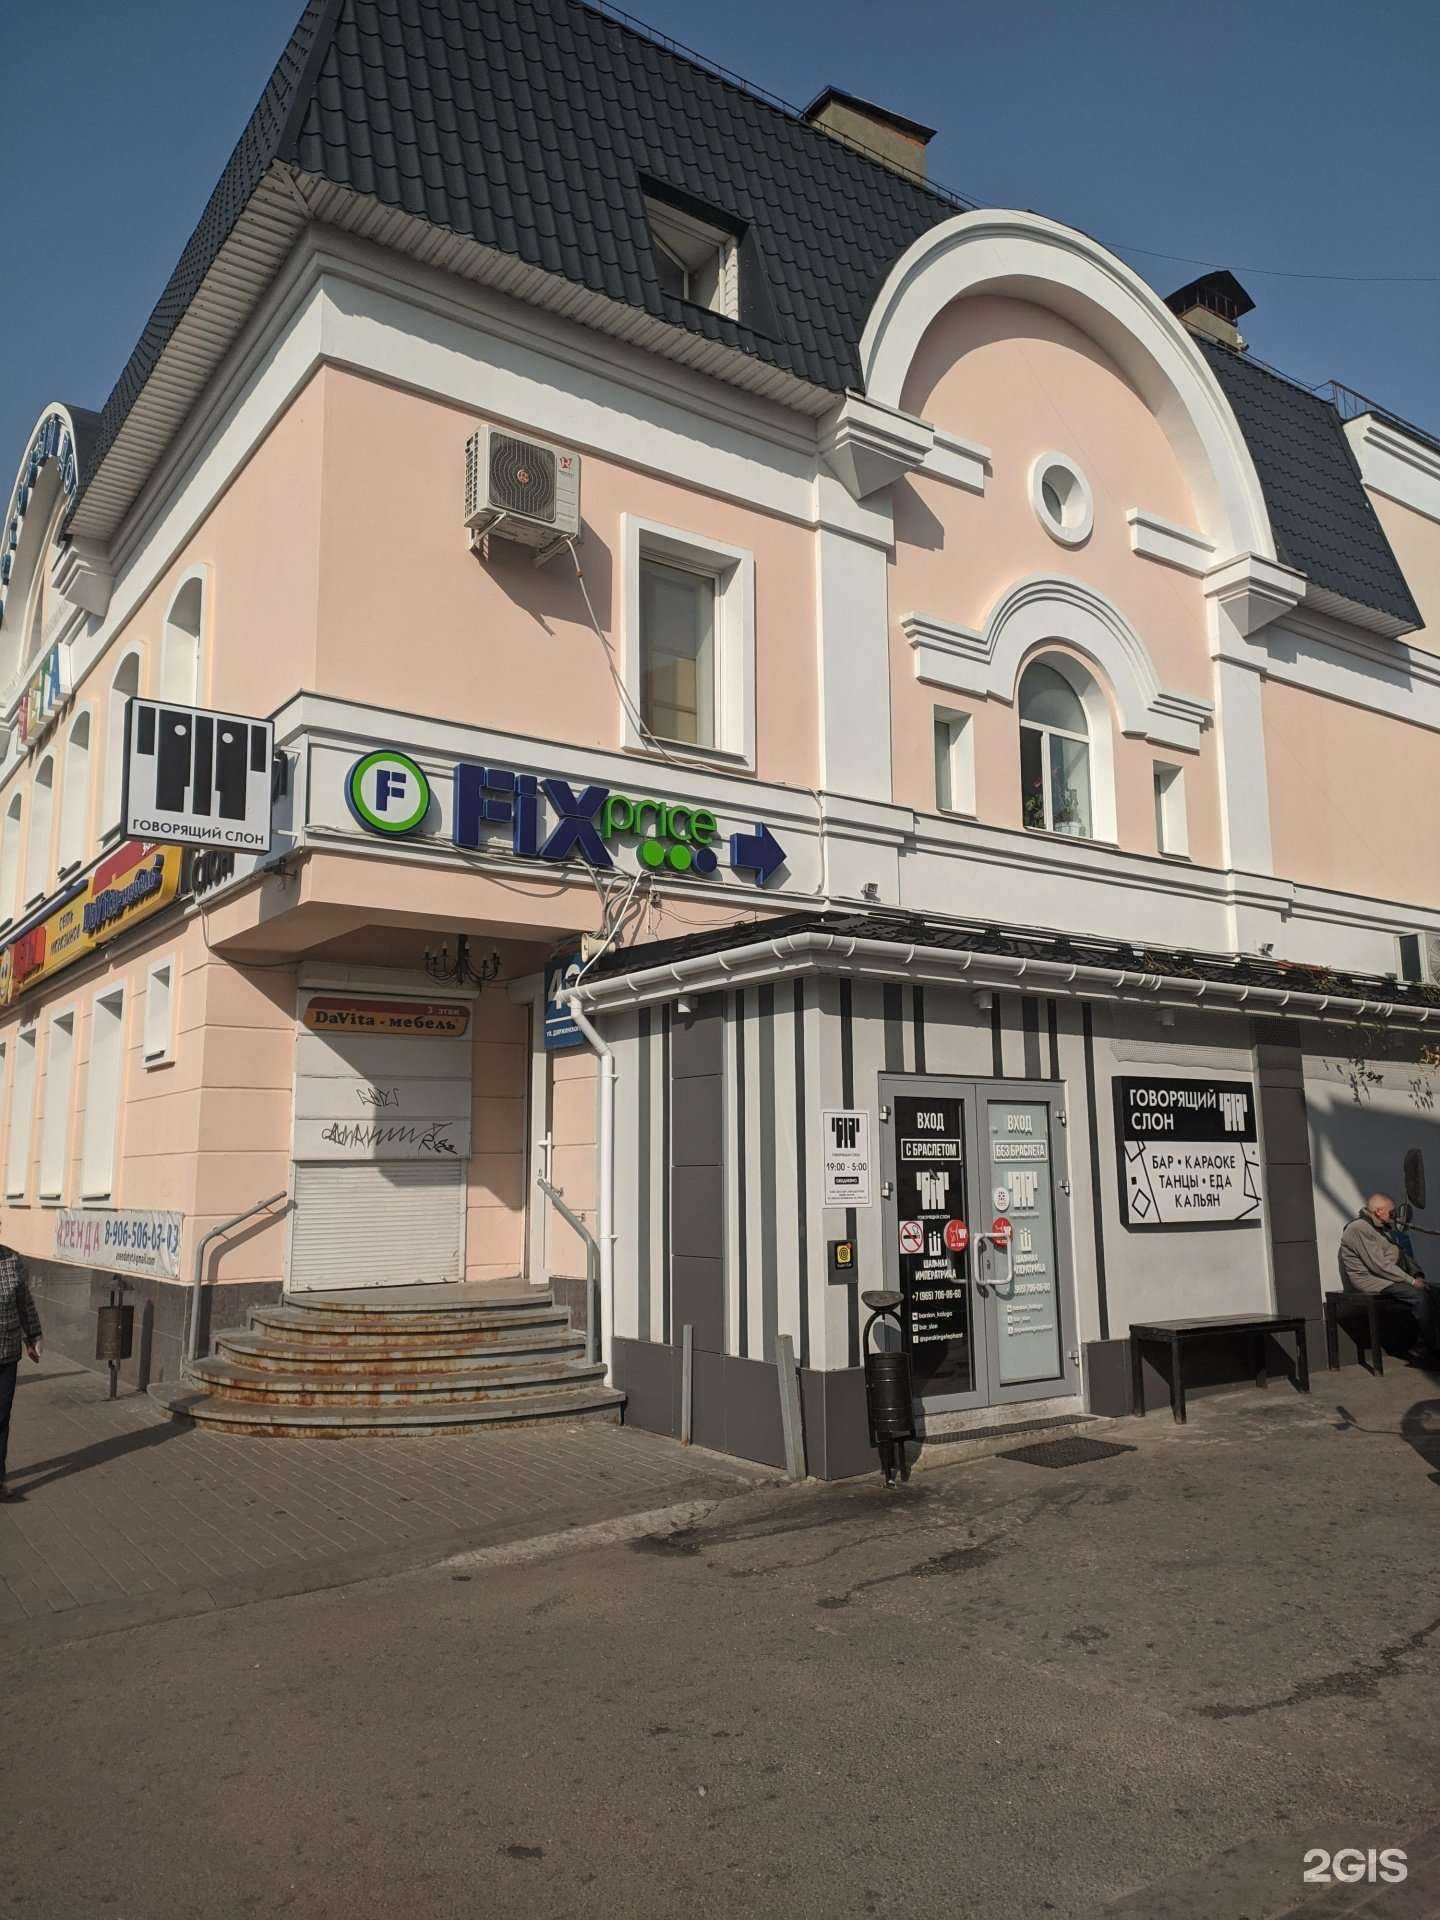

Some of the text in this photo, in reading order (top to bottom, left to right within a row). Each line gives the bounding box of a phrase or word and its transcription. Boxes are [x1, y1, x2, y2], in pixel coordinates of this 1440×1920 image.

[376, 768, 407, 811] F
[602, 794, 718, 845] price
[132, 819, 264, 845] ГОВОРЯЩИЙ СЛОН
[314, 1011, 375, 1026] DaVita
[389, 1015, 456, 1031] мебель
[1129, 1089, 1217, 1111] ГОВОРЯЩИЙ
[917, 1112, 945, 1131] ВХОД
[1008, 1114, 1033, 1132] ВХОД
[1131, 1112, 1174, 1131] СЛОН
[905, 1143, 957, 1156] С БРАСЛЕТОМ
[1152, 1155, 1236, 1169] БАР КАРАОКЕ
[1159, 1174, 1232, 1190] ТАНЦЫ ЕДА
[1175, 1193, 1221, 1208] КАЛЬЯН
